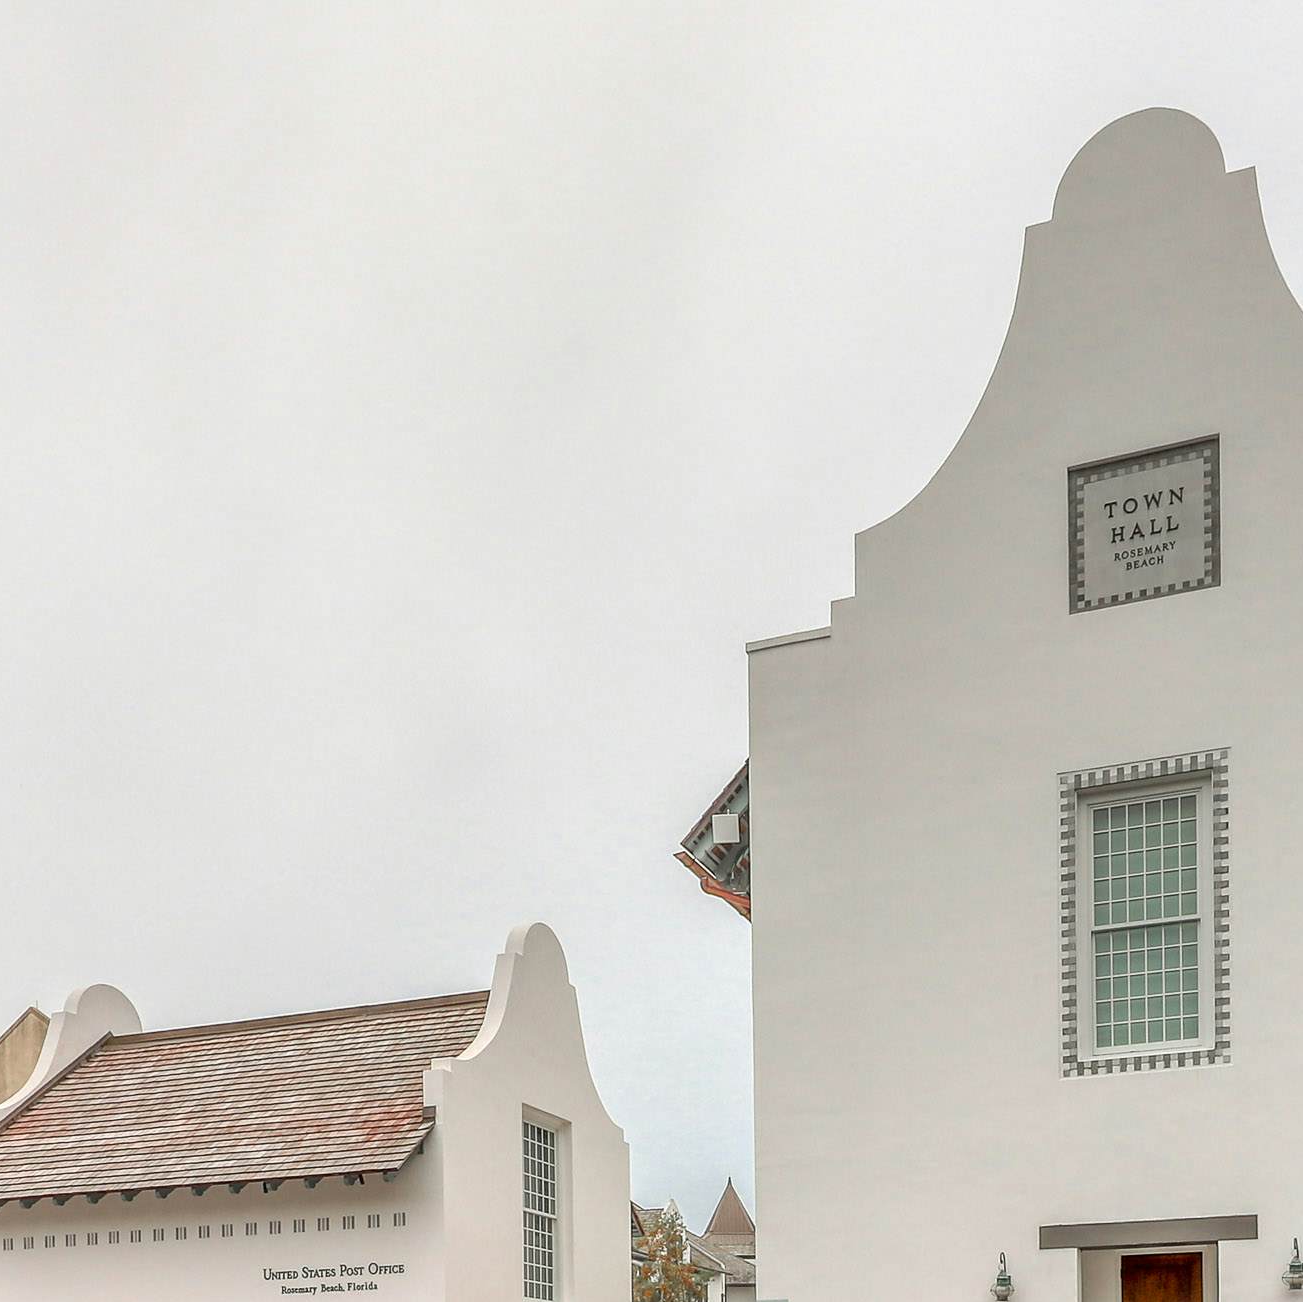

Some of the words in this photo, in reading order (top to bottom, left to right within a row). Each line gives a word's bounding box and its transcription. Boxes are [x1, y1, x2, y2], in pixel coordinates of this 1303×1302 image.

[1104, 487, 1186, 519] TOWN
[1111, 515, 1180, 544] HALL
[1114, 541, 1177, 561] ROSEMARY
[1126, 555, 1165, 571] BEACH
[263, 1268, 298, 1280] UNITED
[302, 1266, 336, 1279] STATES
[340, 1264, 365, 1277] POST
[368, 1262, 405, 1275] OFFICE
[281, 1286, 317, 1295] Rosemary
[347, 1281, 378, 1291] Florida
